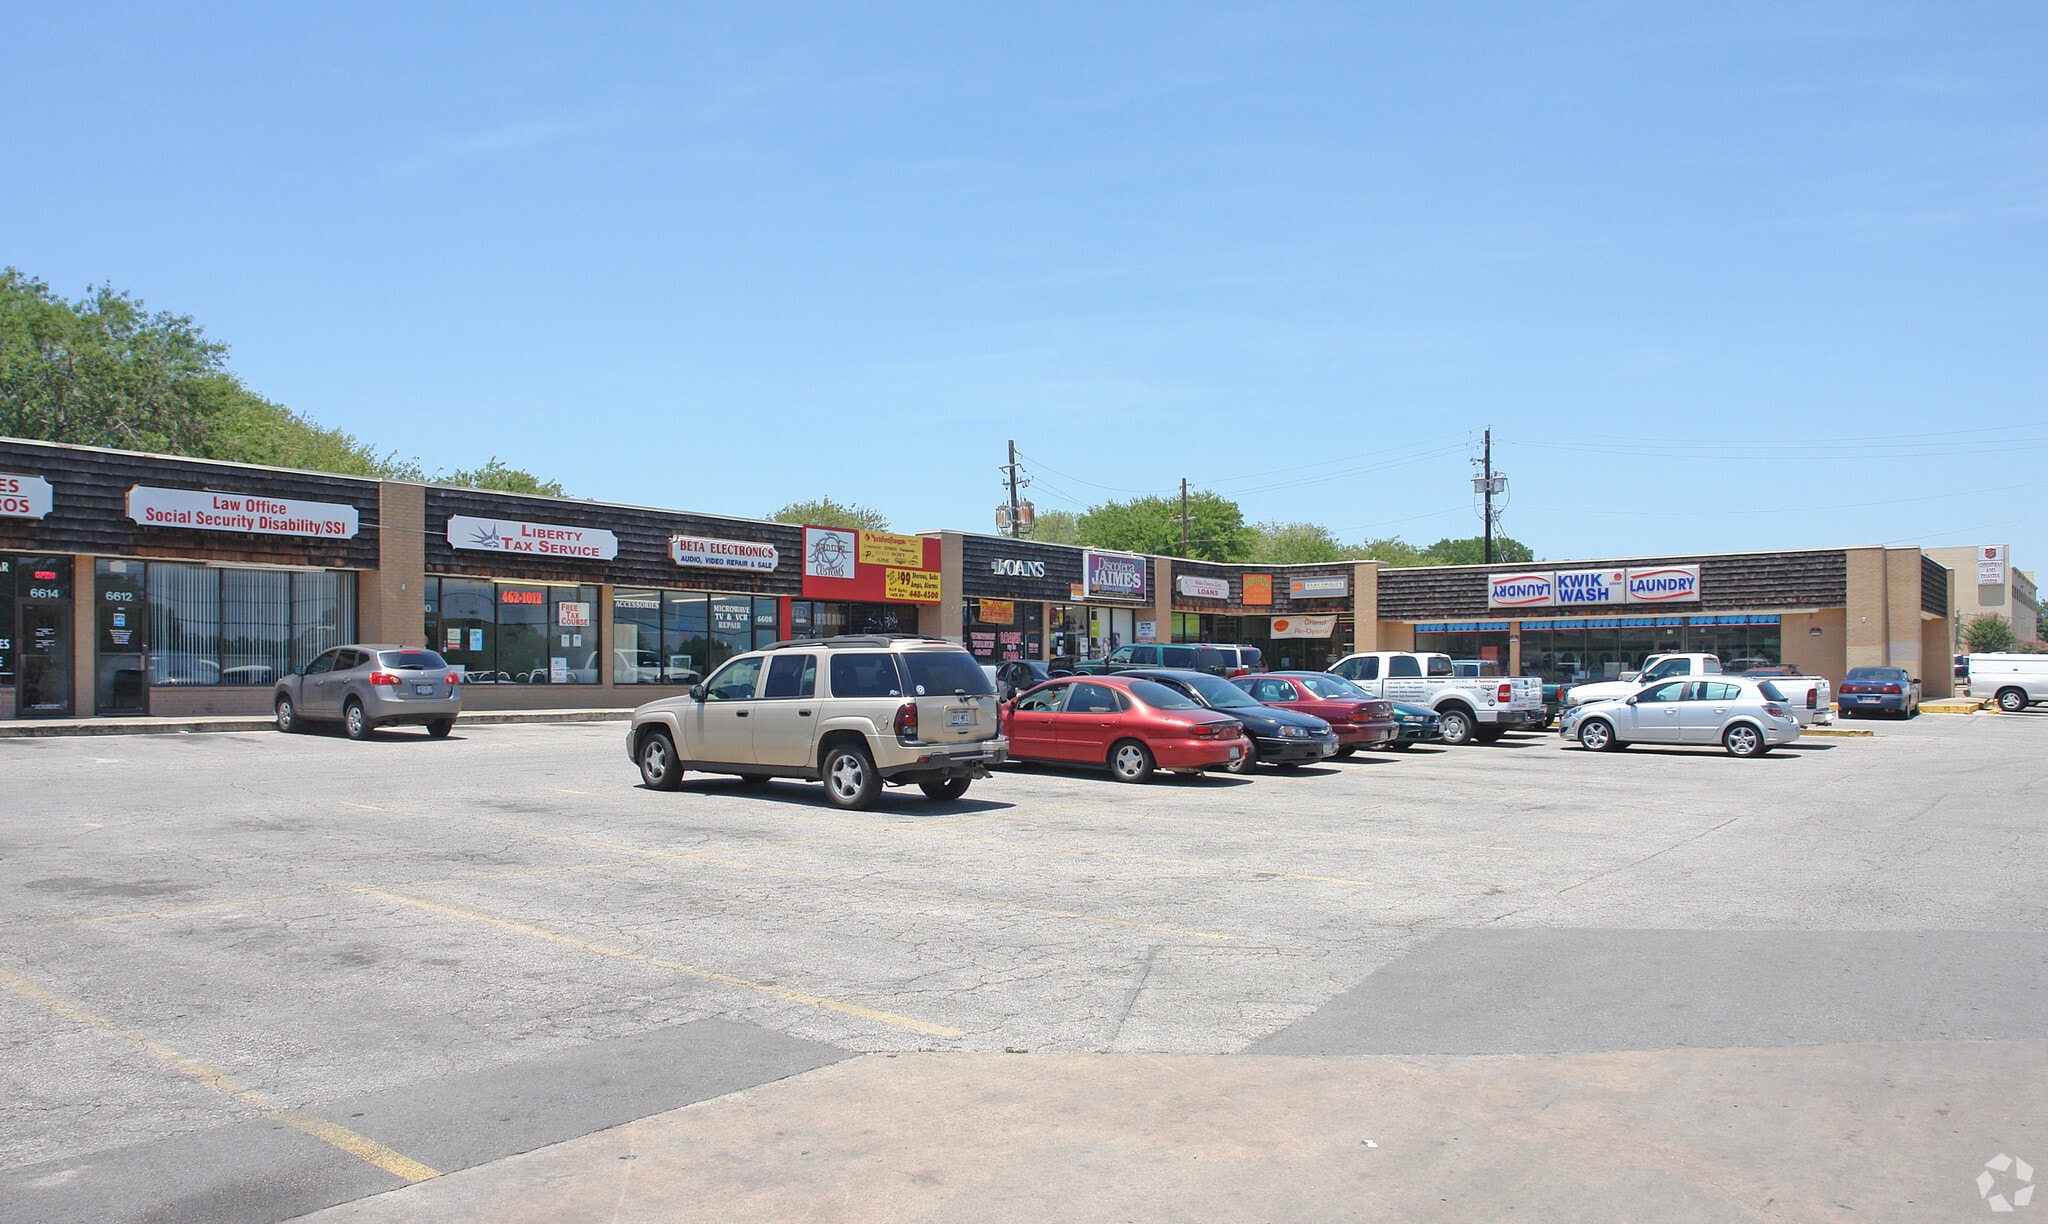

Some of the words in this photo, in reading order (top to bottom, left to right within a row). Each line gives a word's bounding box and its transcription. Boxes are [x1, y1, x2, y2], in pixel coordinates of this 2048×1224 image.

[213, 496, 241, 511] Law
[245, 499, 287, 515] Office
[146, 507, 191, 524] Social
[196, 511, 254, 530] Security
[259, 516, 346, 536] Disability/SSI
[680, 540, 705, 552] BETA
[710, 543, 774, 558] ELECTRONICS
[680, 555, 703, 564] AUDIO,
[726, 559, 748, 567] REPAIR
[992, 558, 1045, 577] LOANS
[1098, 557, 1135, 573] Discoteca
[1092, 570, 1141, 589] JAIMES
[1558, 574, 1602, 588] KWIK
[1629, 577, 1695, 592] LAUNDRY
[30, 588, 59, 599] 6614
[106, 591, 133, 602] 6612
[1197, 588, 1219, 597] LOANS
[1492, 584, 1551, 597] LAUNDRY
[1559, 587, 1609, 602] WASH
[501, 590, 543, 605] 462-1012
[561, 603, 579, 612] FREE
[615, 600, 660, 610] ACCESSORIES
[713, 604, 751, 614] MICROWAVE
[561, 617, 588, 626] COURSE
[735, 614, 749, 622] VCR
[718, 621, 742, 630] REPAIR
